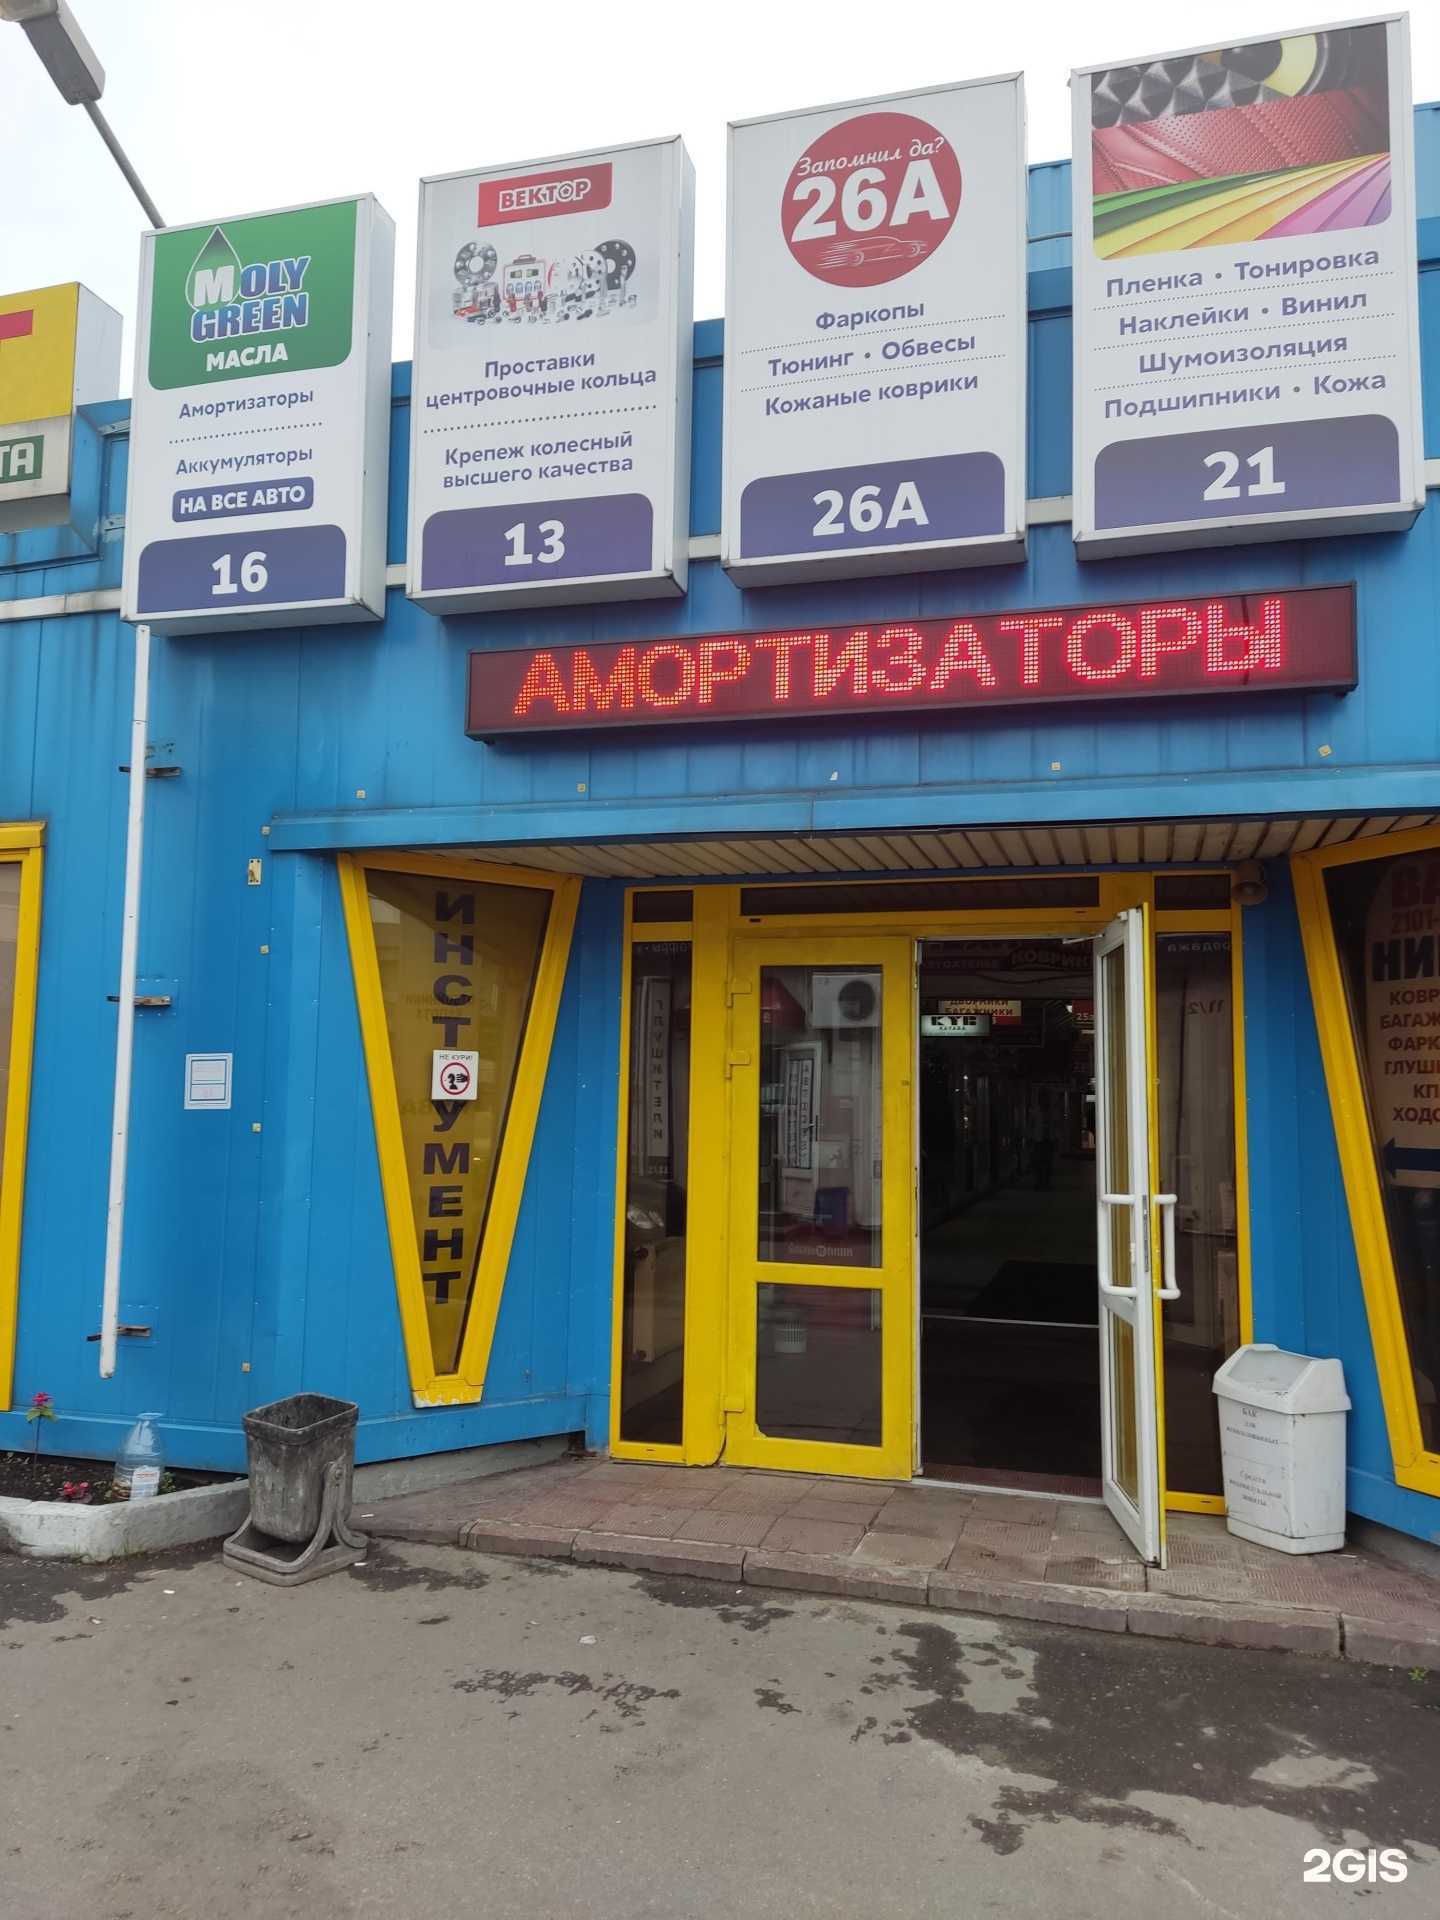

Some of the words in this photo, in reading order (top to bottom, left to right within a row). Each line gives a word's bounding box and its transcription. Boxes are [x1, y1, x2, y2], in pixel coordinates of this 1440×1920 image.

[797, 149, 901, 176] Запомнил
[909, 136, 944, 158] да?
[499, 179, 592, 212] ВЕКТОР
[791, 158, 949, 243] 26А
[192, 255, 311, 309] MOLY
[1106, 271, 1203, 298] Пленка
[1234, 250, 1379, 281] Тонировка
[190, 293, 309, 343] GREEN
[815, 302, 924, 331] Фаркопы
[1119, 304, 1249, 336] Наклейки
[1281, 292, 1367, 316] Винил
[206, 343, 288, 371] МАСЛА
[485, 351, 595, 378] Проставки
[768, 350, 854, 378] Тюнинг
[881, 335, 975, 361] Обвесы
[1139, 336, 1347, 375] Шумоизоляция
[179, 389, 314, 419] Амортизаторы
[425, 375, 576, 408] центровочные
[581, 368, 656, 392] кольца
[765, 387, 872, 416] Кожаные
[878, 373, 978, 402] коврики
[1105, 385, 1280, 418] Подшипники
[1313, 375, 1386, 395] Кожа
[175, 446, 313, 477] Аккумуляторы
[445, 444, 524, 467] Крепеж
[530, 432, 633, 457] колесный
[442, 464, 533, 488] высшего
[538, 457, 633, 479] качества
[1203, 446, 1286, 501] 21
[179, 495, 208, 514] НА
[211, 491, 248, 511] ВСЕ
[252, 485, 306, 507] АВТО
[812, 481, 929, 537] 26А
[503, 519, 566, 566] 13
[211, 551, 269, 595] 16
[514, 599, 1282, 717] АМОРТИЗАТОРЫ
[1371, 937, 1440, 982] НИ
[423, 891, 476, 1305] ИНСТУМЕНТ
